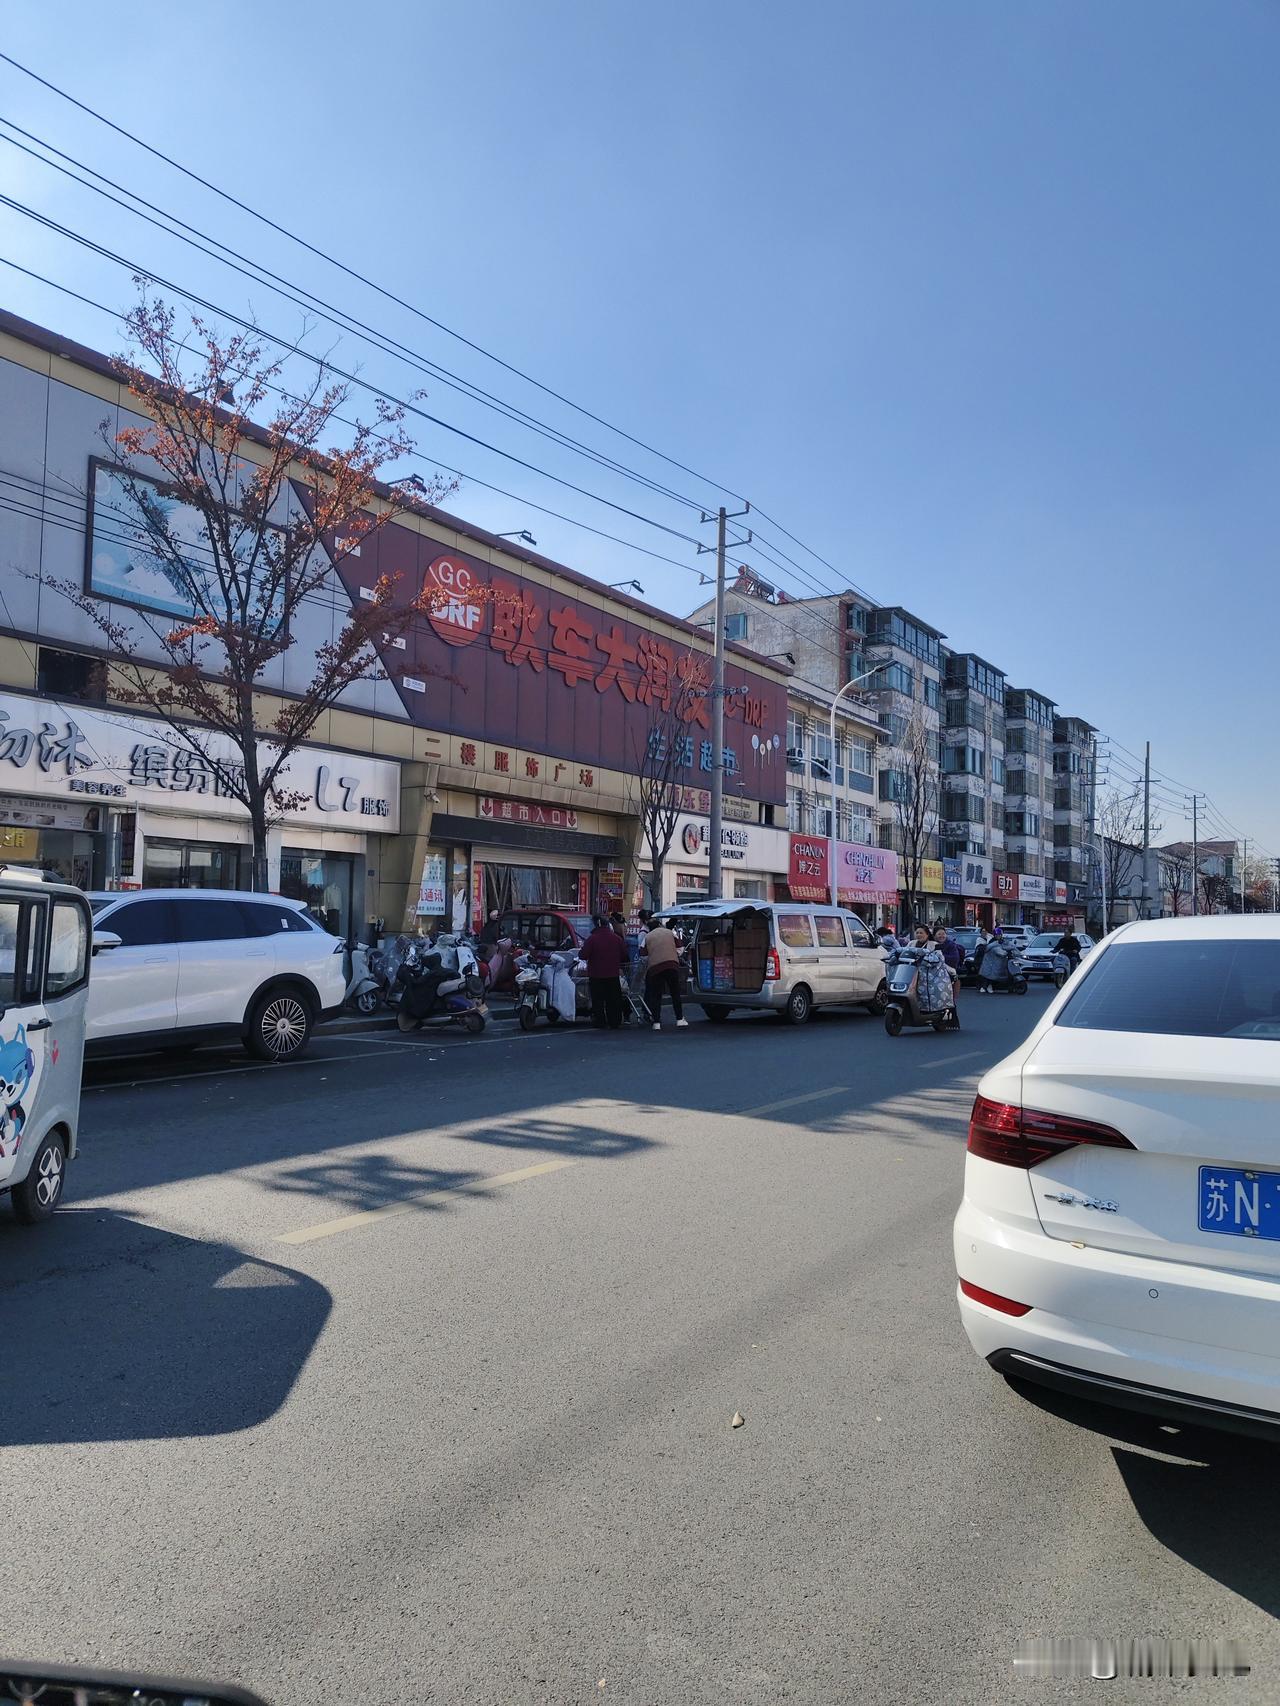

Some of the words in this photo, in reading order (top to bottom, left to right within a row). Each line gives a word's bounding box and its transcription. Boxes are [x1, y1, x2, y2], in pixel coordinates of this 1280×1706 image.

[438, 561, 471, 590] GC
[430, 598, 481, 630] DRF
[425, 737, 594, 788] 二楼服饰广场
[70, 779, 127, 798] 美容养生
[361, 796, 391, 817] 服饰
[501, 801, 562, 824] 超市入口
[998, 875, 1013, 890] 回力
[1206, 1178, 1280, 1226] 苏N·
